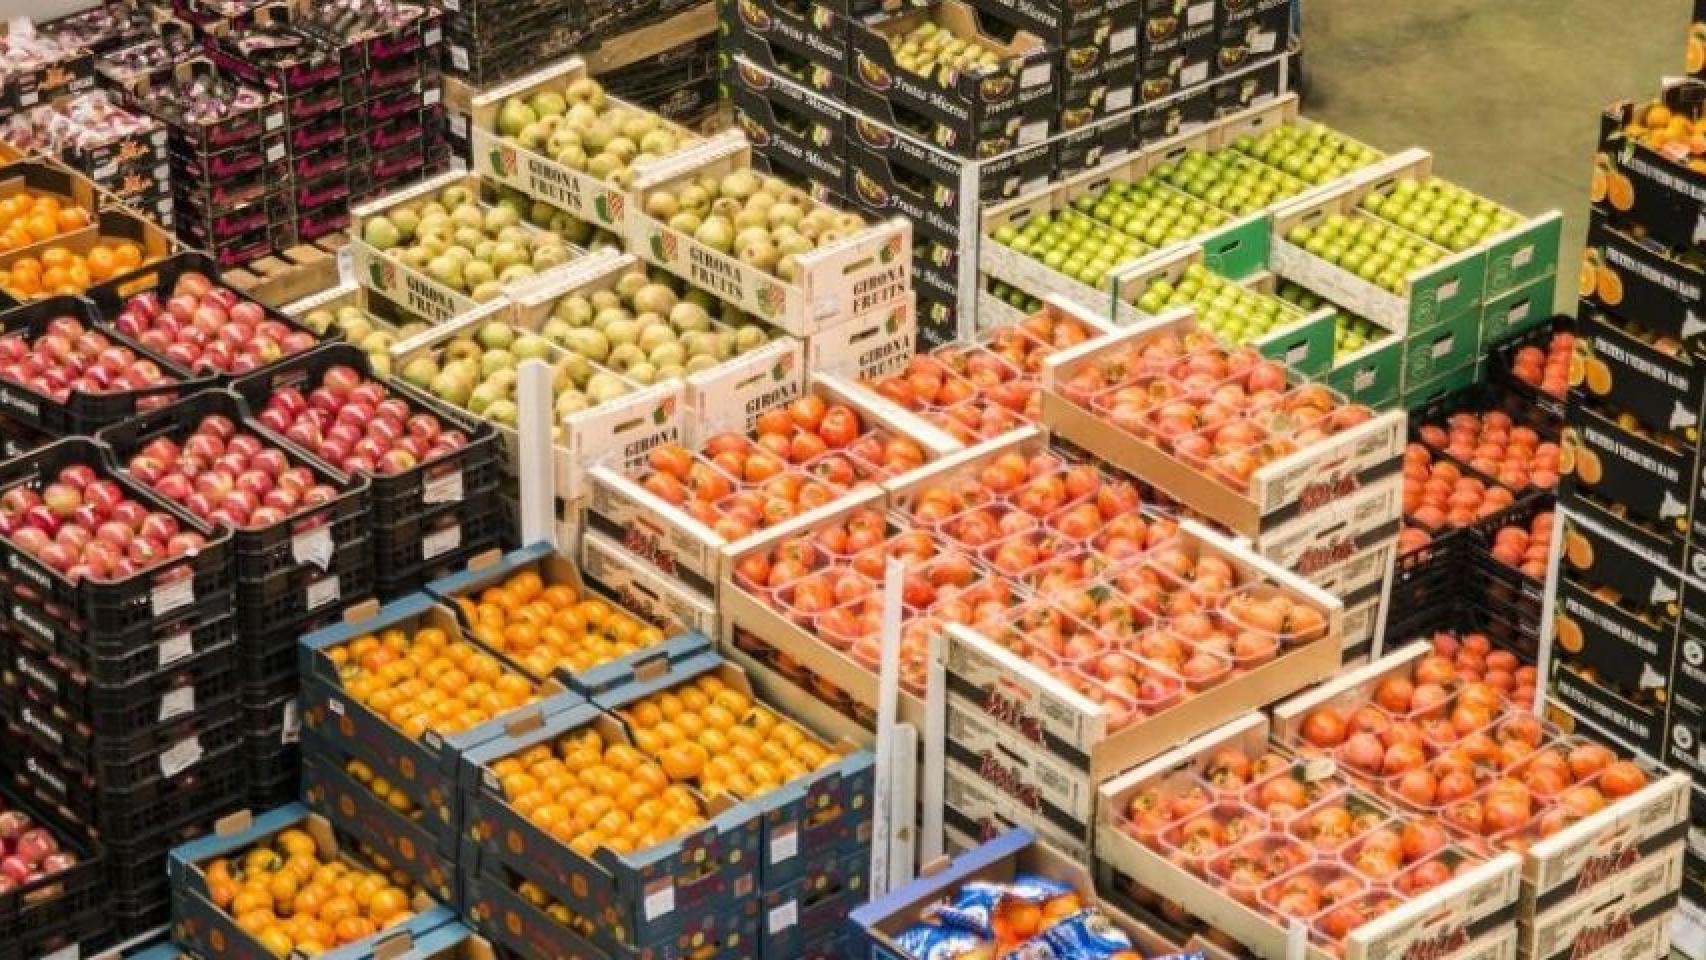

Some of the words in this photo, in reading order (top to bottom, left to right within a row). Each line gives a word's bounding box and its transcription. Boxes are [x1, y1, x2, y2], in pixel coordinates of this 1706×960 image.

[529, 159, 581, 193] GIRONA
[530, 176, 583, 211] FRUITS
[689, 245, 742, 283] GIRONA
[853, 264, 904, 296] GIRONA
[406, 274, 455, 313] GIRONA
[691, 263, 743, 301] FRUITS
[853, 284, 904, 313] FRUITS
[859, 335, 908, 367] GIRONA
[745, 382, 797, 414] GIRONA
[624, 428, 678, 457] GIRONA
